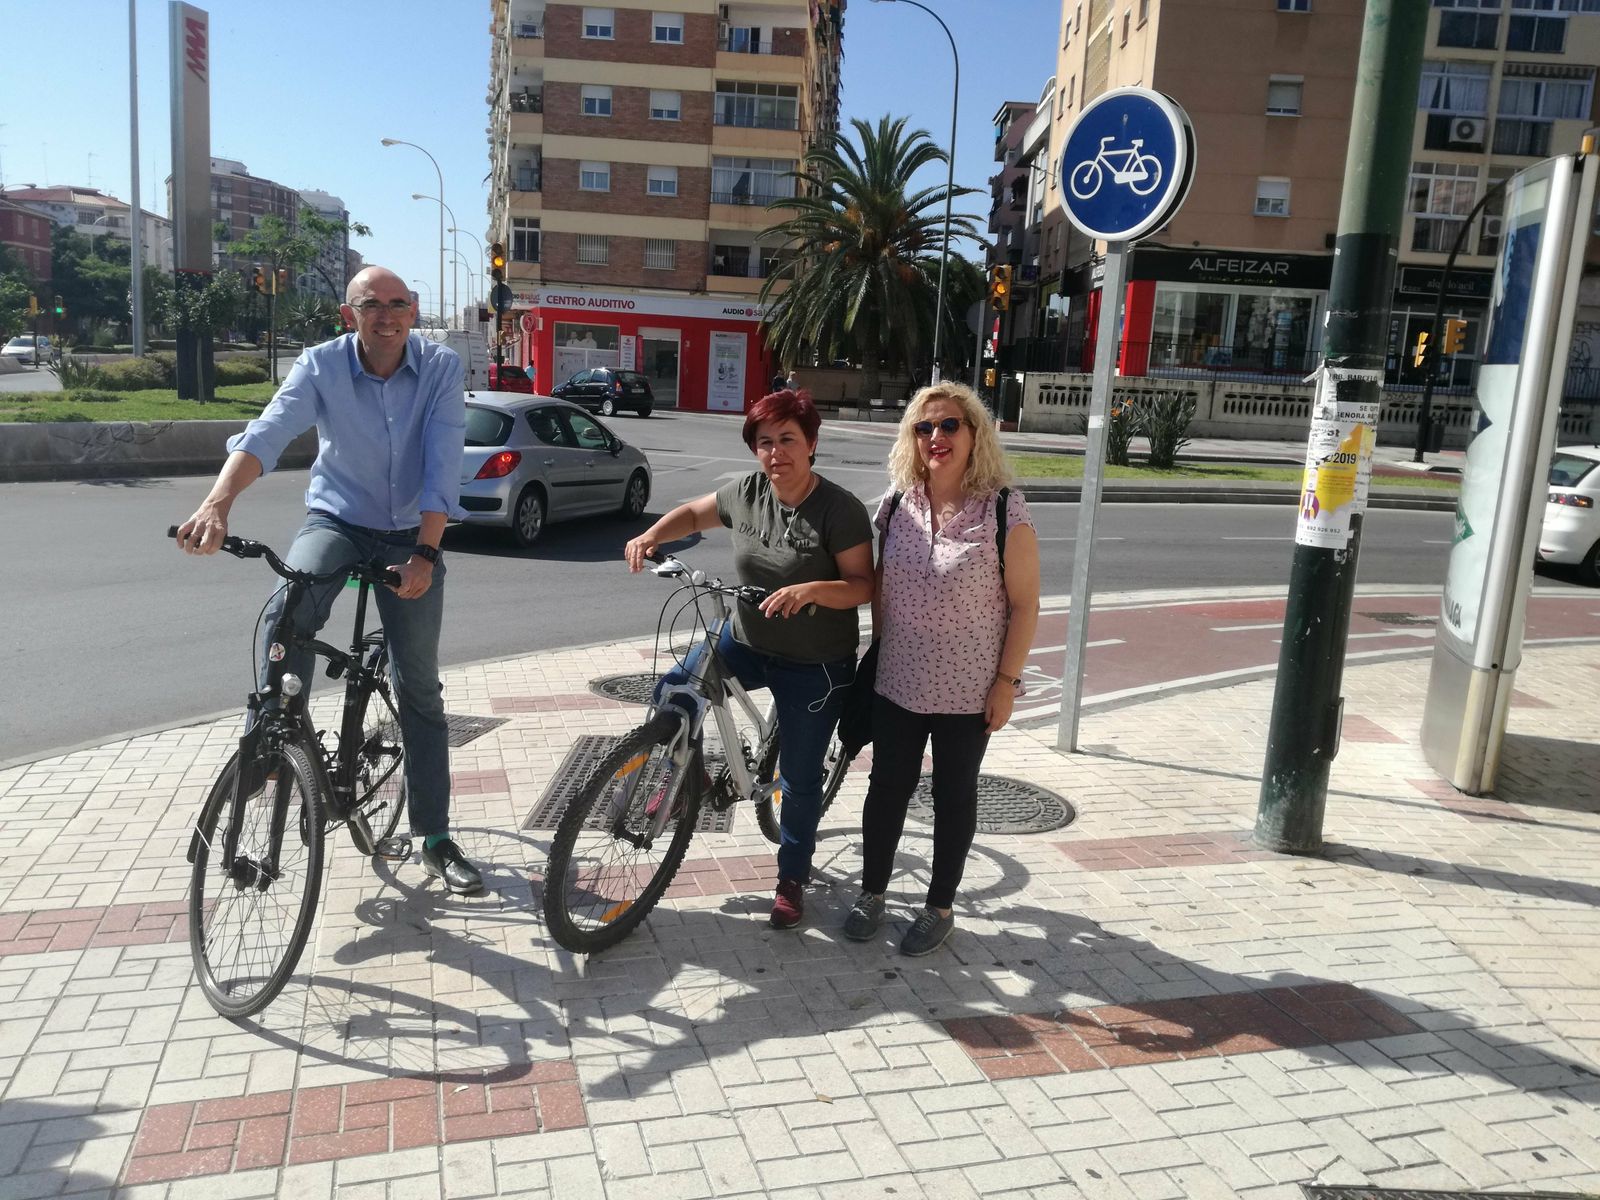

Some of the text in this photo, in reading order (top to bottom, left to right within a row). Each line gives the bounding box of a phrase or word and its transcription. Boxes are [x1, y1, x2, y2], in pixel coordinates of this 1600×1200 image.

[1189, 257, 1290, 276] ALFEIZAR
[546, 294, 635, 310] CENTRO AUDITIVO
[722, 307, 745, 315] AUDIO
[1334, 452, 1357, 465] 2019
